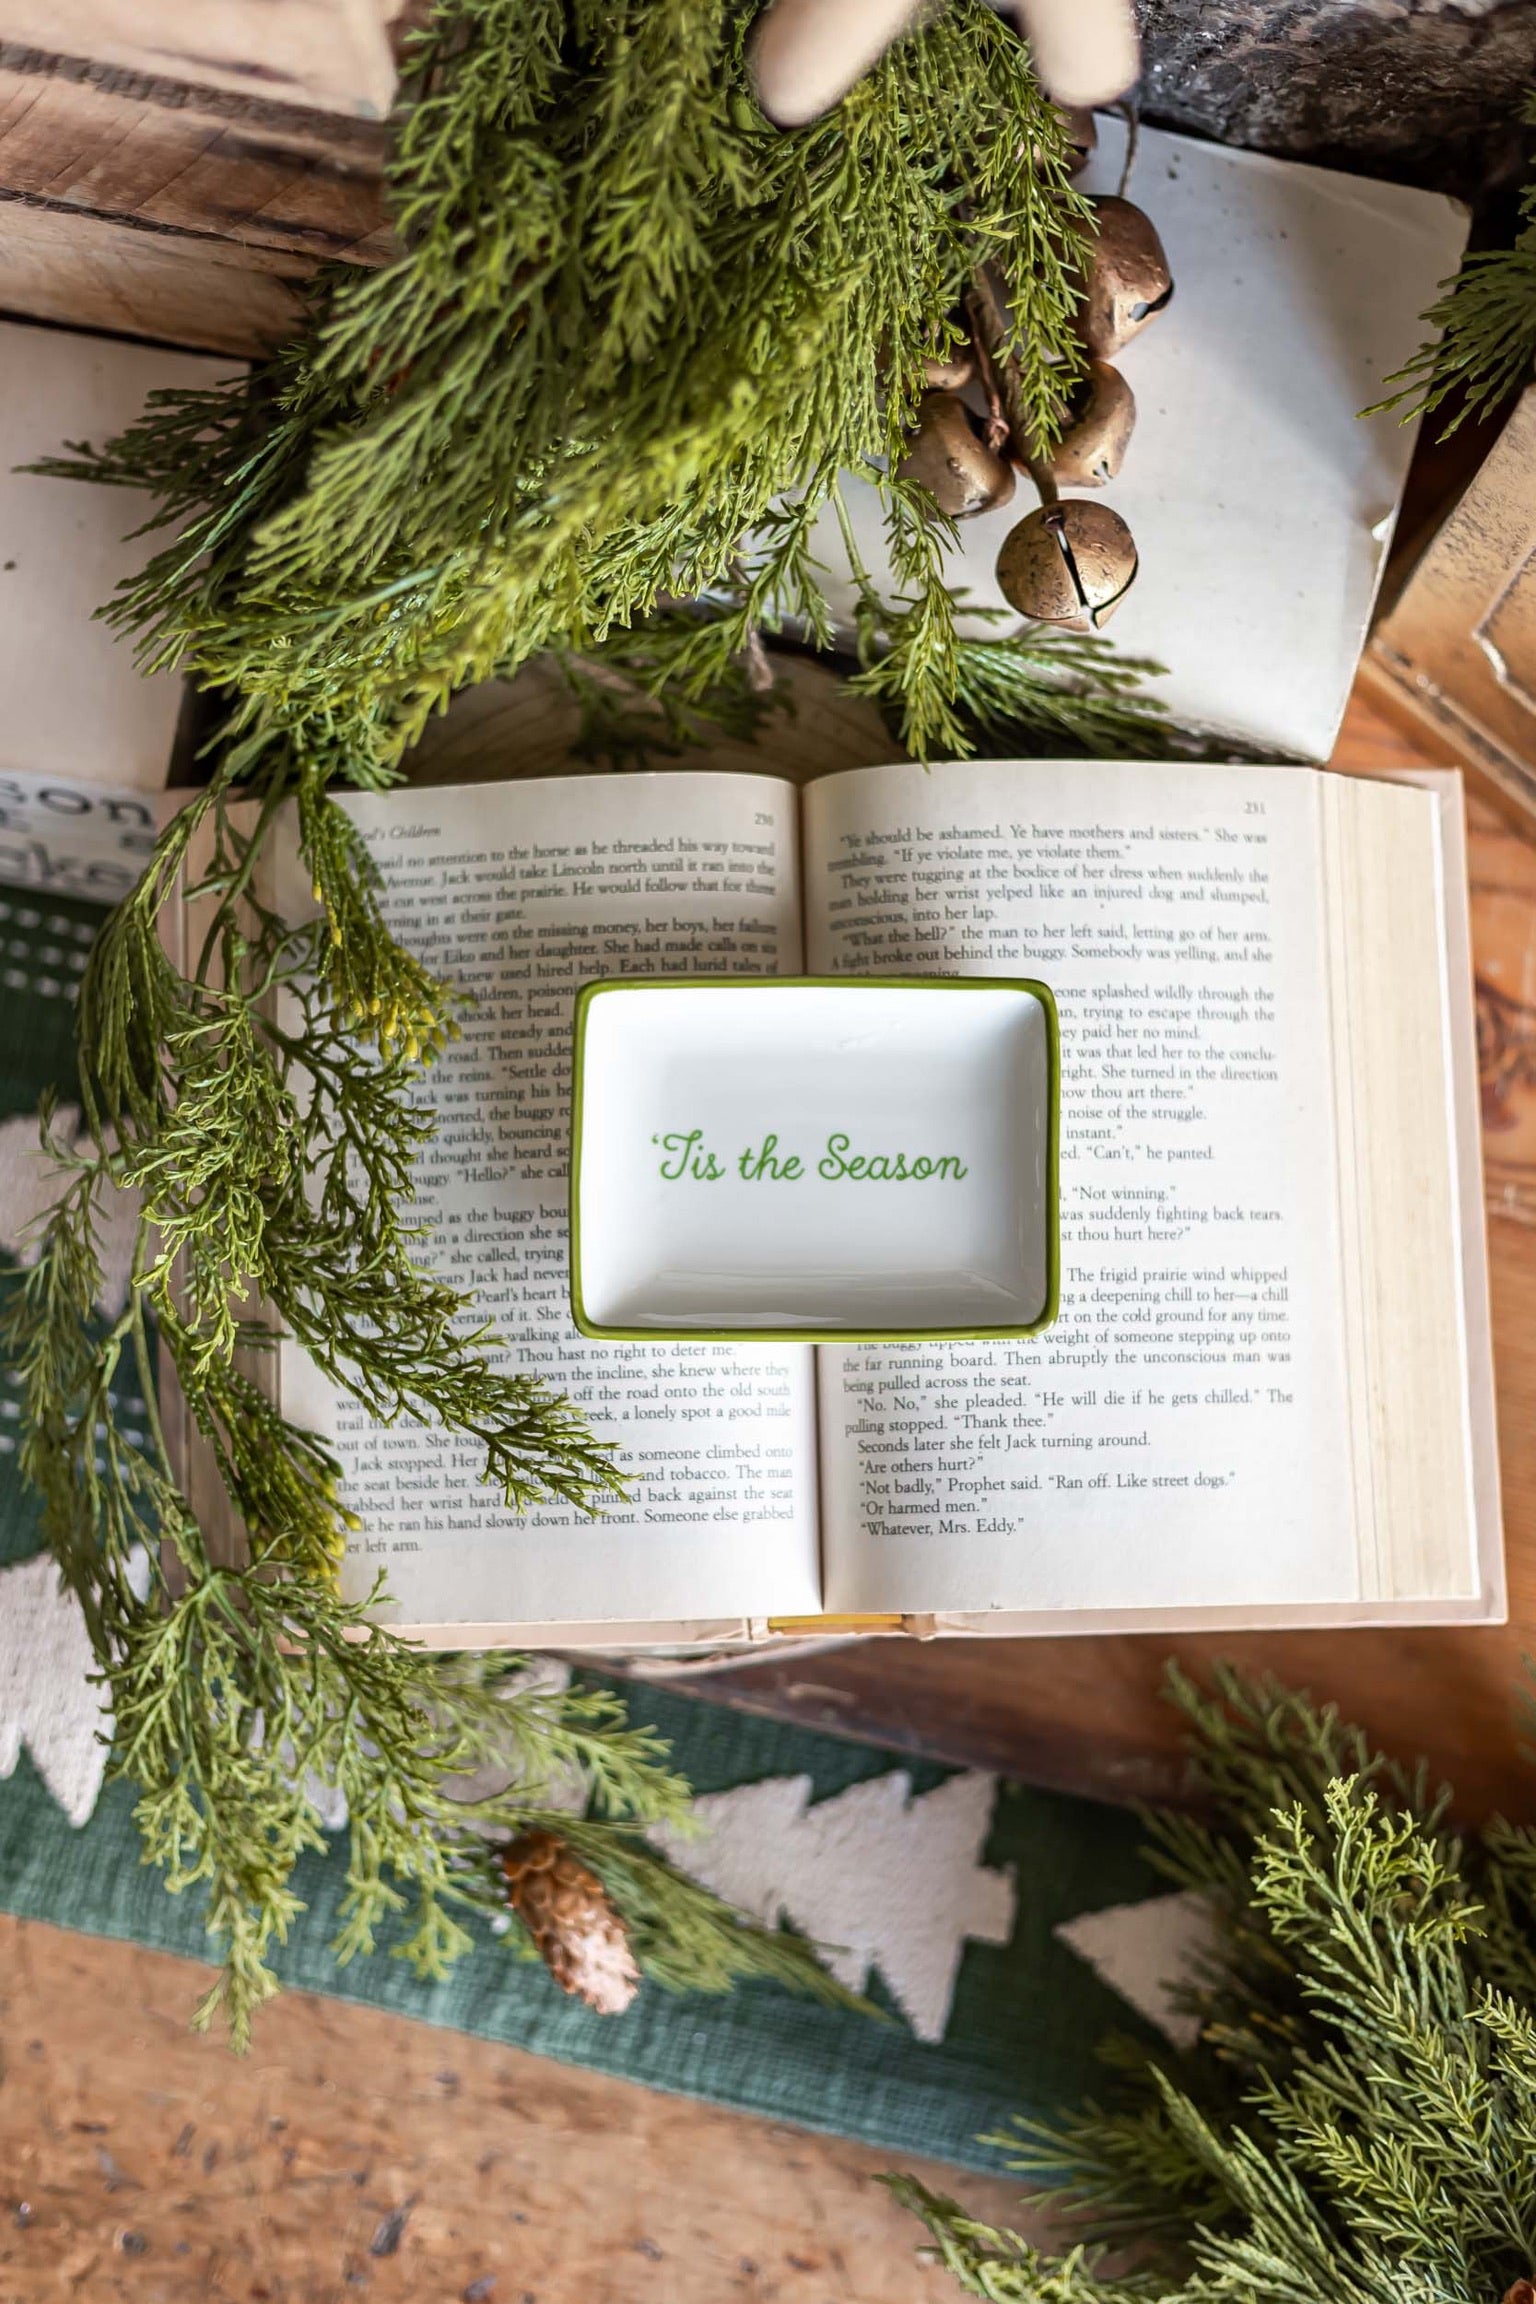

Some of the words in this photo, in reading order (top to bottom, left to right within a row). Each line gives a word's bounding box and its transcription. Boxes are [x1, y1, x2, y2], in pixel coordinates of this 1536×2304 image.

[917, 851, 932, 864] ye
[937, 846, 983, 860] violate
[988, 848, 1012, 860] me,
[1018, 847, 1032, 859] ye
[1037, 844, 1080, 859] violate
[520, 865, 548, 879] take
[609, 860, 647, 874] north
[652, 858, 684, 872] until
[645, 918, 667, 932] her
[604, 940, 629, 954] She
[634, 938, 660, 952] had
[665, 937, 702, 951] made
[1092, 984, 1149, 1000] splashed
[1154, 985, 1193, 1001] wildly
[1198, 986, 1249, 1002] through
[1091, 1084, 1122, 1098] thou
[1127, 1086, 1145, 1098] art
[1068, 1105, 1103, 1119] noise
[1108, 1104, 1122, 1119] of
[1127, 1105, 1147, 1119] the
[1152, 1106, 1207, 1122] struggle.
[652, 1130, 725, 1180] 'Tis
[739, 1134, 805, 1180] the
[818, 1134, 967, 1180] Season
[1147, 1145, 1162, 1160] he
[1168, 1145, 1215, 1162] panted.
[1059, 1208, 1083, 1220] was
[1089, 1206, 1151, 1222] suddenly
[1156, 1206, 1209, 1223] fighting
[1213, 1206, 1244, 1220] back
[1250, 1208, 1283, 1221] tears.
[1078, 1227, 1109, 1241] thou
[1114, 1226, 1143, 1241] hurt
[1067, 1267, 1094, 1281] The
[1100, 1267, 1137, 1284] frigid
[1143, 1267, 1187, 1283] prairie
[1192, 1267, 1225, 1281] wind
[1230, 1267, 1287, 1283] whipped
[1080, 1291, 1086, 1302] a
[1091, 1288, 1160, 1305] deepening
[1165, 1287, 1192, 1302] chill
[1197, 1289, 1209, 1301] to
[1261, 1287, 1288, 1301] chill
[1074, 1311, 1091, 1322] on
[1096, 1308, 1118, 1322] the
[1122, 1308, 1151, 1322] cold
[1156, 1308, 1203, 1324] ground
[1208, 1307, 1226, 1322] for
[1231, 1310, 1253, 1324] any
[1258, 1308, 1289, 1322] time.
[1044, 1328, 1090, 1346] weight
[1095, 1328, 1109, 1343] of
[1114, 1330, 1173, 1343] someone
[1178, 1329, 1234, 1345] stepping
[1239, 1330, 1256, 1344] up
[1261, 1330, 1291, 1341] onto
[613, 1346, 645, 1360] right
[652, 1346, 666, 1357] to
[671, 1344, 706, 1357] deter
[843, 1358, 859, 1373] the
[865, 1356, 882, 1370] far
[888, 1355, 943, 1371] running
[950, 1353, 996, 1367] board.
[1004, 1351, 1041, 1365] Then
[1048, 1349, 1108, 1367] abruptly
[1115, 1348, 1137, 1364] the
[1143, 1348, 1226, 1363] unconscious
[1232, 1350, 1260, 1362] man
[1268, 1350, 1291, 1362] was
[597, 1365, 647, 1381] incline,
[652, 1364, 675, 1378] she
[679, 1363, 716, 1377] knew
[721, 1362, 761, 1376] where
[573, 1386, 593, 1400] off
[600, 1385, 620, 1399] the
[627, 1385, 659, 1399] road
[664, 1385, 697, 1398] onto
[730, 1381, 752, 1396] old
[844, 1379, 874, 1393] being
[878, 1375, 920, 1393] pulled
[925, 1376, 968, 1388] across
[974, 1373, 995, 1387] the
[1001, 1375, 1031, 1386] seat.
[935, 1395, 959, 1409] she
[966, 1393, 1026, 1410] pleaded.
[1072, 1391, 1096, 1406] will
[1104, 1390, 1125, 1405] die
[1132, 1389, 1143, 1404] if
[1149, 1389, 1165, 1404] he
[1171, 1391, 1198, 1407] gets
[1266, 1389, 1293, 1403] The
[635, 1405, 676, 1422] lonely
[681, 1407, 711, 1421] spot
[845, 1419, 884, 1437] pulling
[889, 1416, 947, 1435] stopped.
[383, 1436, 419, 1450] town.
[426, 1434, 450, 1448] She
[858, 1438, 909, 1454] Seconds
[914, 1437, 945, 1451] later
[950, 1435, 974, 1450] she
[979, 1434, 1000, 1449] felt
[1005, 1433, 1037, 1451] Jack
[1042, 1434, 1093, 1449] turning
[1098, 1431, 1151, 1447] around.
[354, 1456, 383, 1474] Jack
[388, 1454, 445, 1473] stopped.
[452, 1453, 477, 1468] Her
[891, 1458, 933, 1472] others
[338, 1477, 358, 1491] the
[364, 1477, 390, 1491] seat
[396, 1475, 439, 1490] beside
[444, 1474, 469, 1488] her.
[948, 1478, 1005, 1496] Prophet
[1010, 1475, 1043, 1490] said.
[1088, 1473, 1111, 1488] off.
[1117, 1473, 1148, 1487] Like
[1152, 1475, 1189, 1487] street
[888, 1499, 940, 1514] harmed
[939, 1519, 970, 1533] Mrs.
